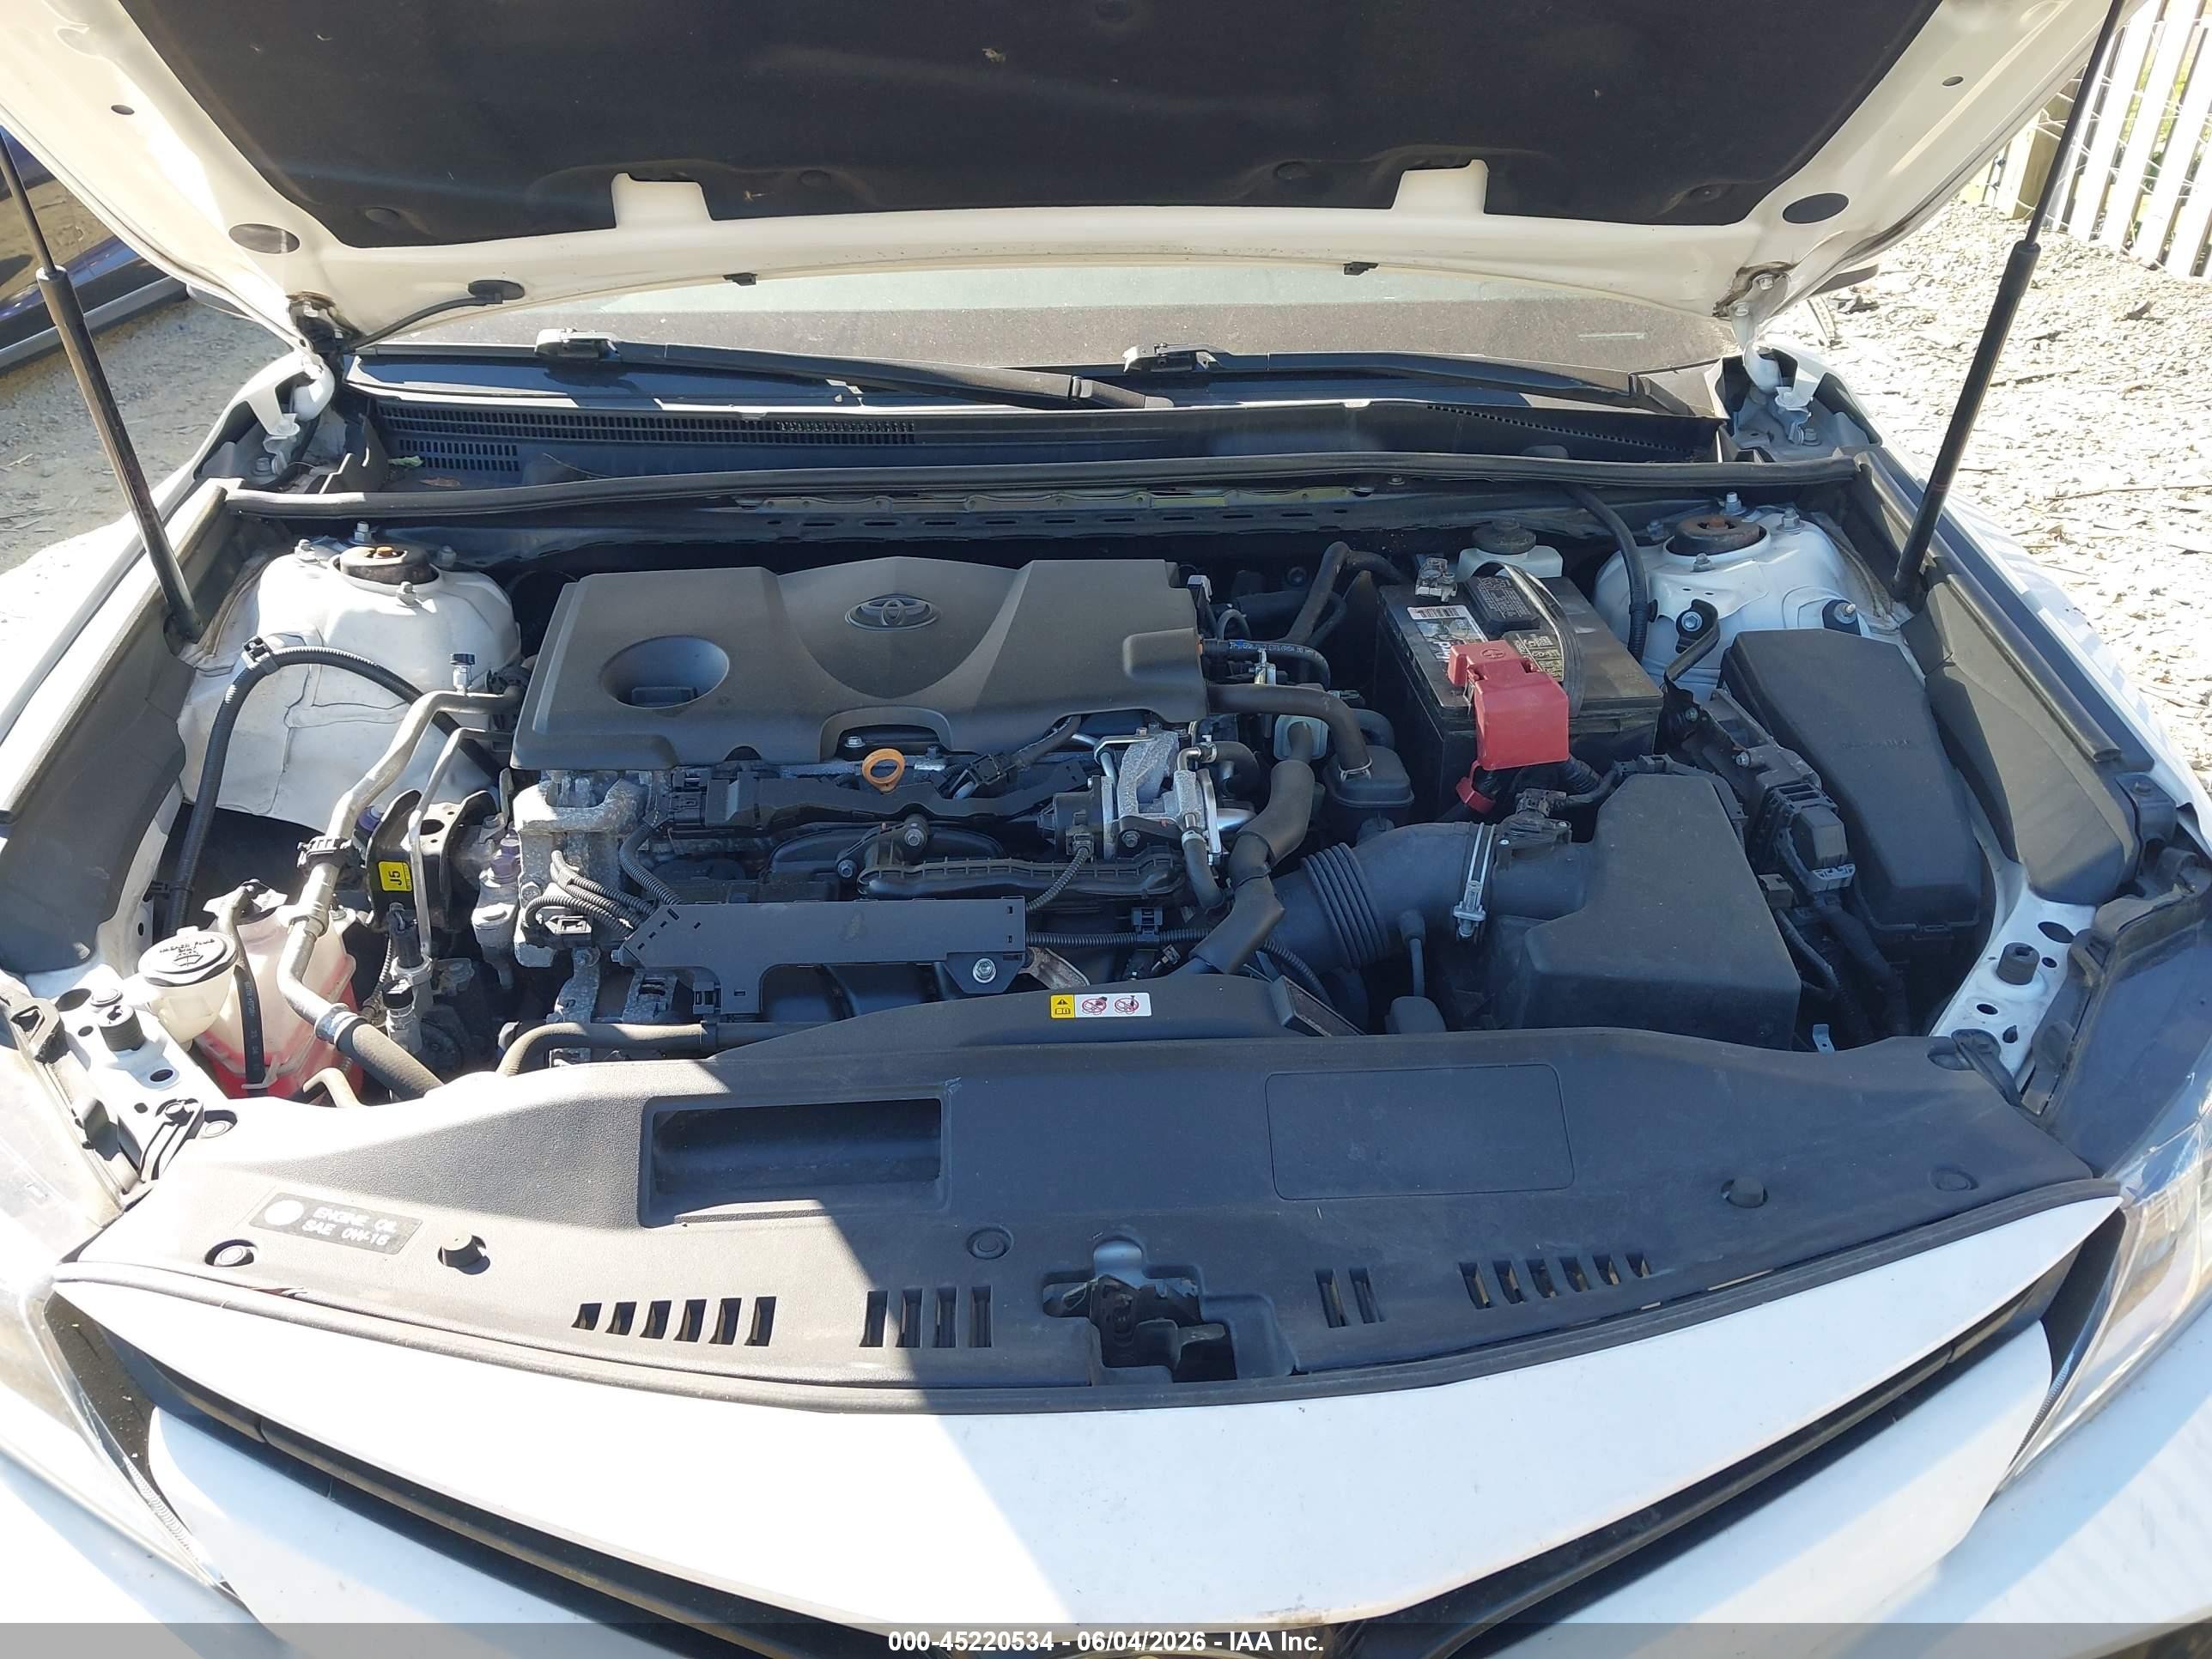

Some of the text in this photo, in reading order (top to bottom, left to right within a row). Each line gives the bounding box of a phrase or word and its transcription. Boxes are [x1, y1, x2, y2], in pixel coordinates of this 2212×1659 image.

[388, 870, 403, 886] J5
[313, 1206, 370, 1227] ENGINE
[301, 1218, 337, 1236] SAE
